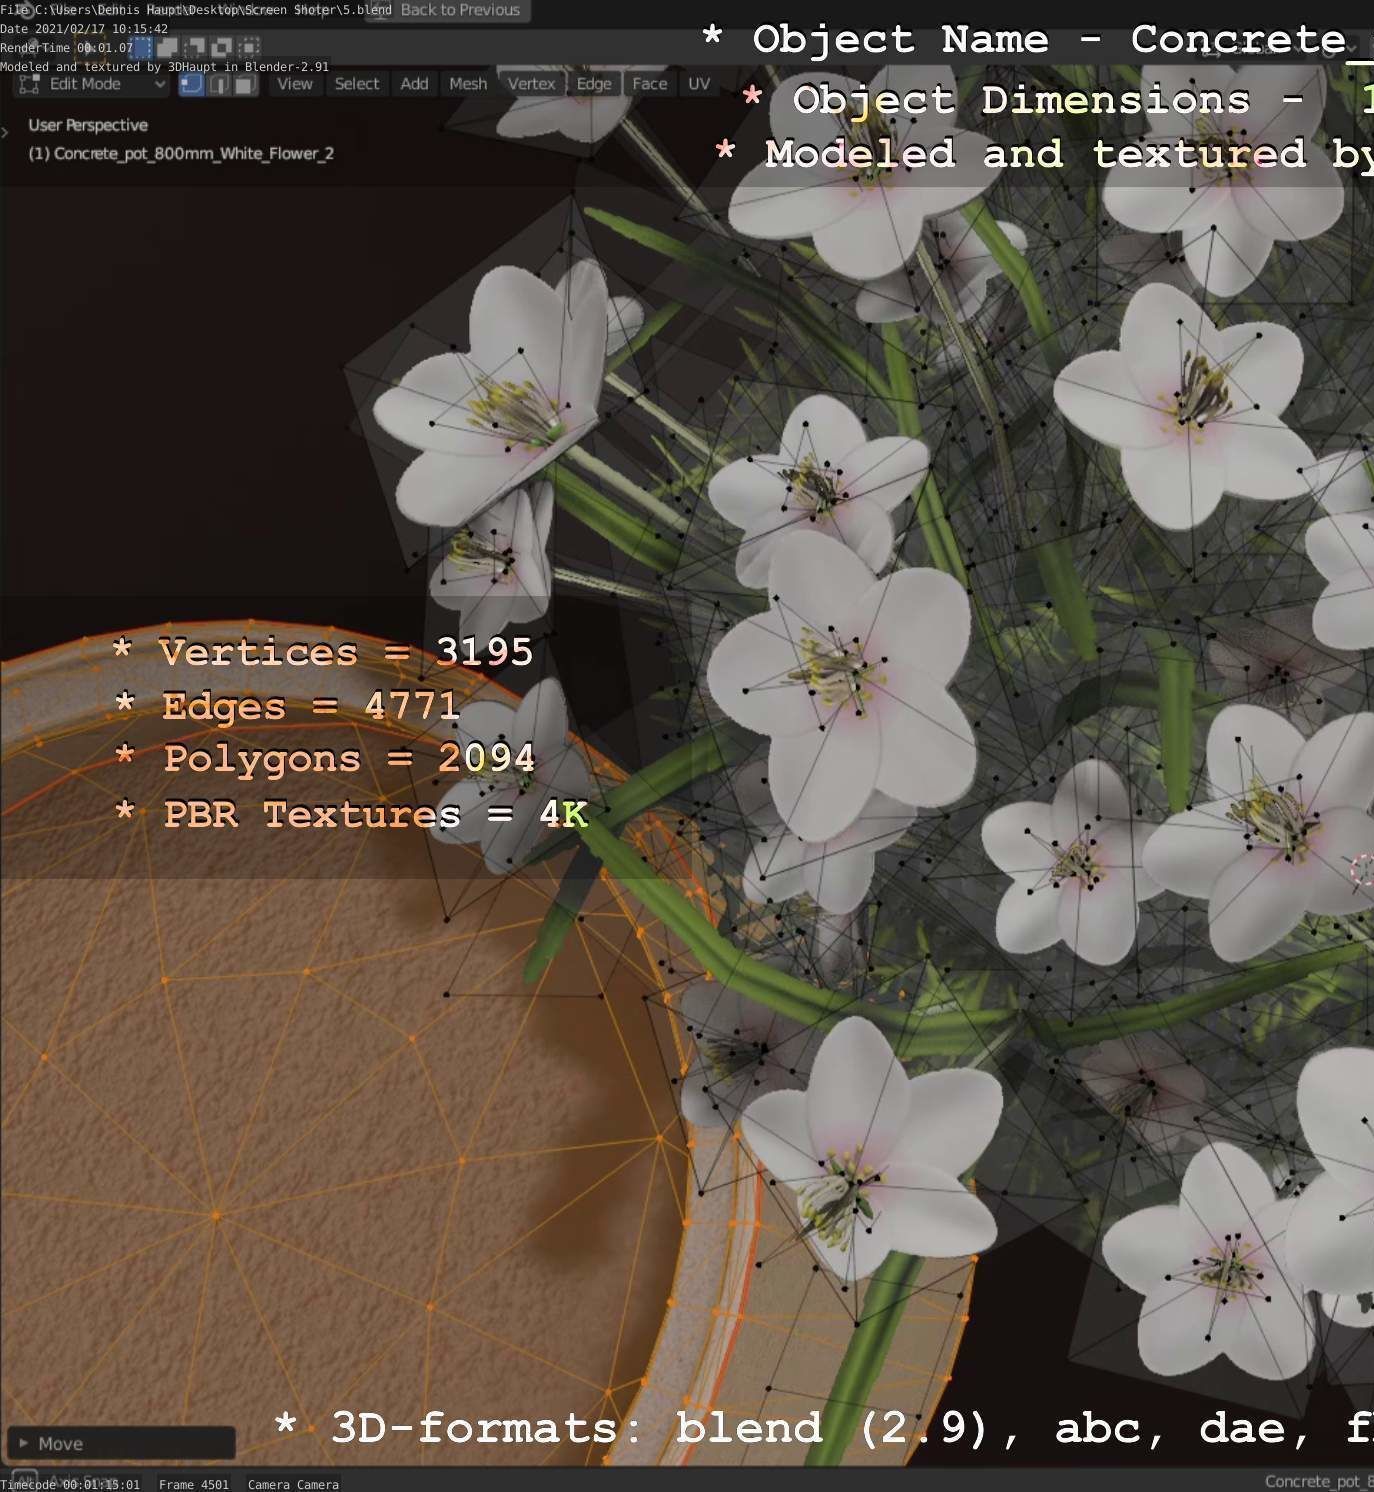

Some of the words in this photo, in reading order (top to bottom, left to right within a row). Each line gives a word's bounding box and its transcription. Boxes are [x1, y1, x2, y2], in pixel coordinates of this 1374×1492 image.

[401, 2, 437, 17] Back
[443, 3, 456, 17] to
[460, 3, 520, 17] Previous
[50, 76, 80, 91] Edit
[84, 76, 121, 91] Mode
[277, 76, 313, 91] View
[335, 76, 380, 91] Select
[401, 76, 429, 91] Add
[449, 76, 488, 91] Mesh
[508, 76, 556, 91] Vertex
[577, 76, 611, 95] Edge
[633, 76, 668, 91] Face
[688, 76, 711, 91] UV
[28, 117, 63, 132] User
[66, 117, 148, 135] Perspective
[28, 145, 50, 163] (1)
[54, 146, 334, 164] Concrete_pot_800mm_White_Flower_2
[39, 1437, 83, 1451] Move
